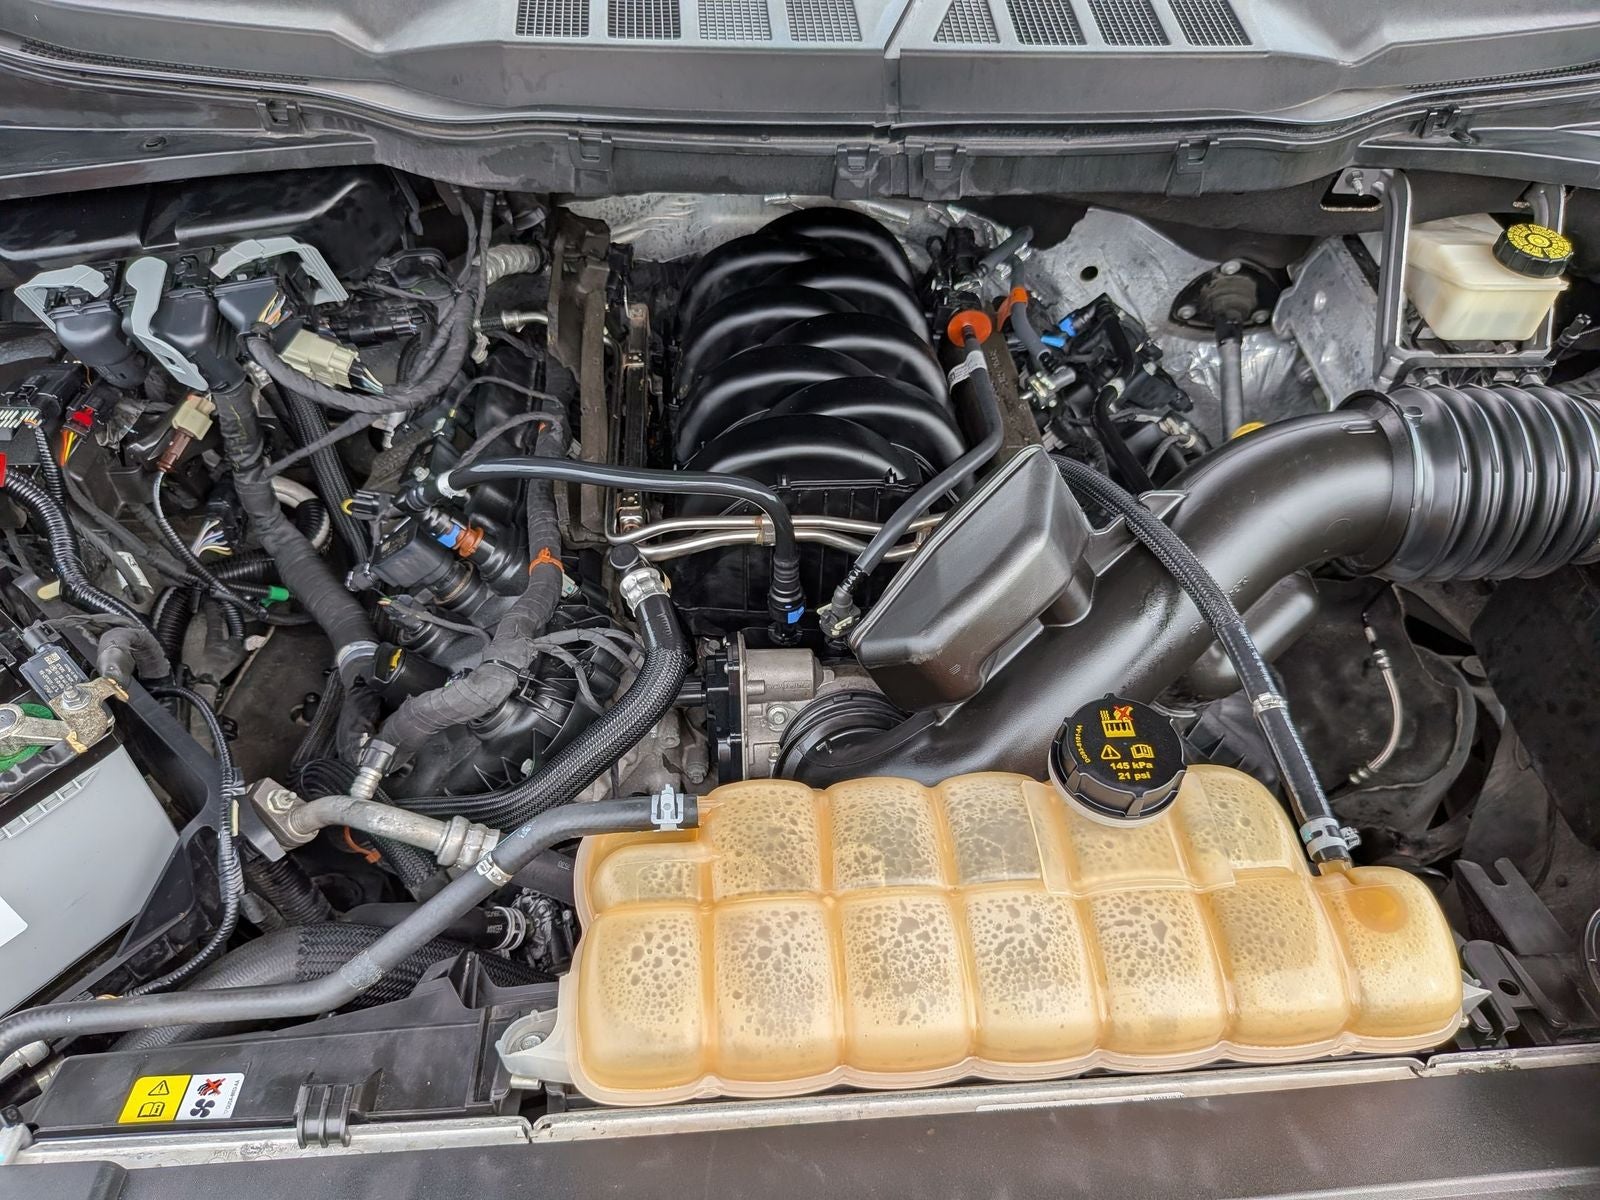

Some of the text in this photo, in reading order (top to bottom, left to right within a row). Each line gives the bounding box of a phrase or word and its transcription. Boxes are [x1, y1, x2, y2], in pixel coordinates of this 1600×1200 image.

[1109, 761, 1153, 770] 145 kPa
[1117, 771, 1151, 781] 21 psi
